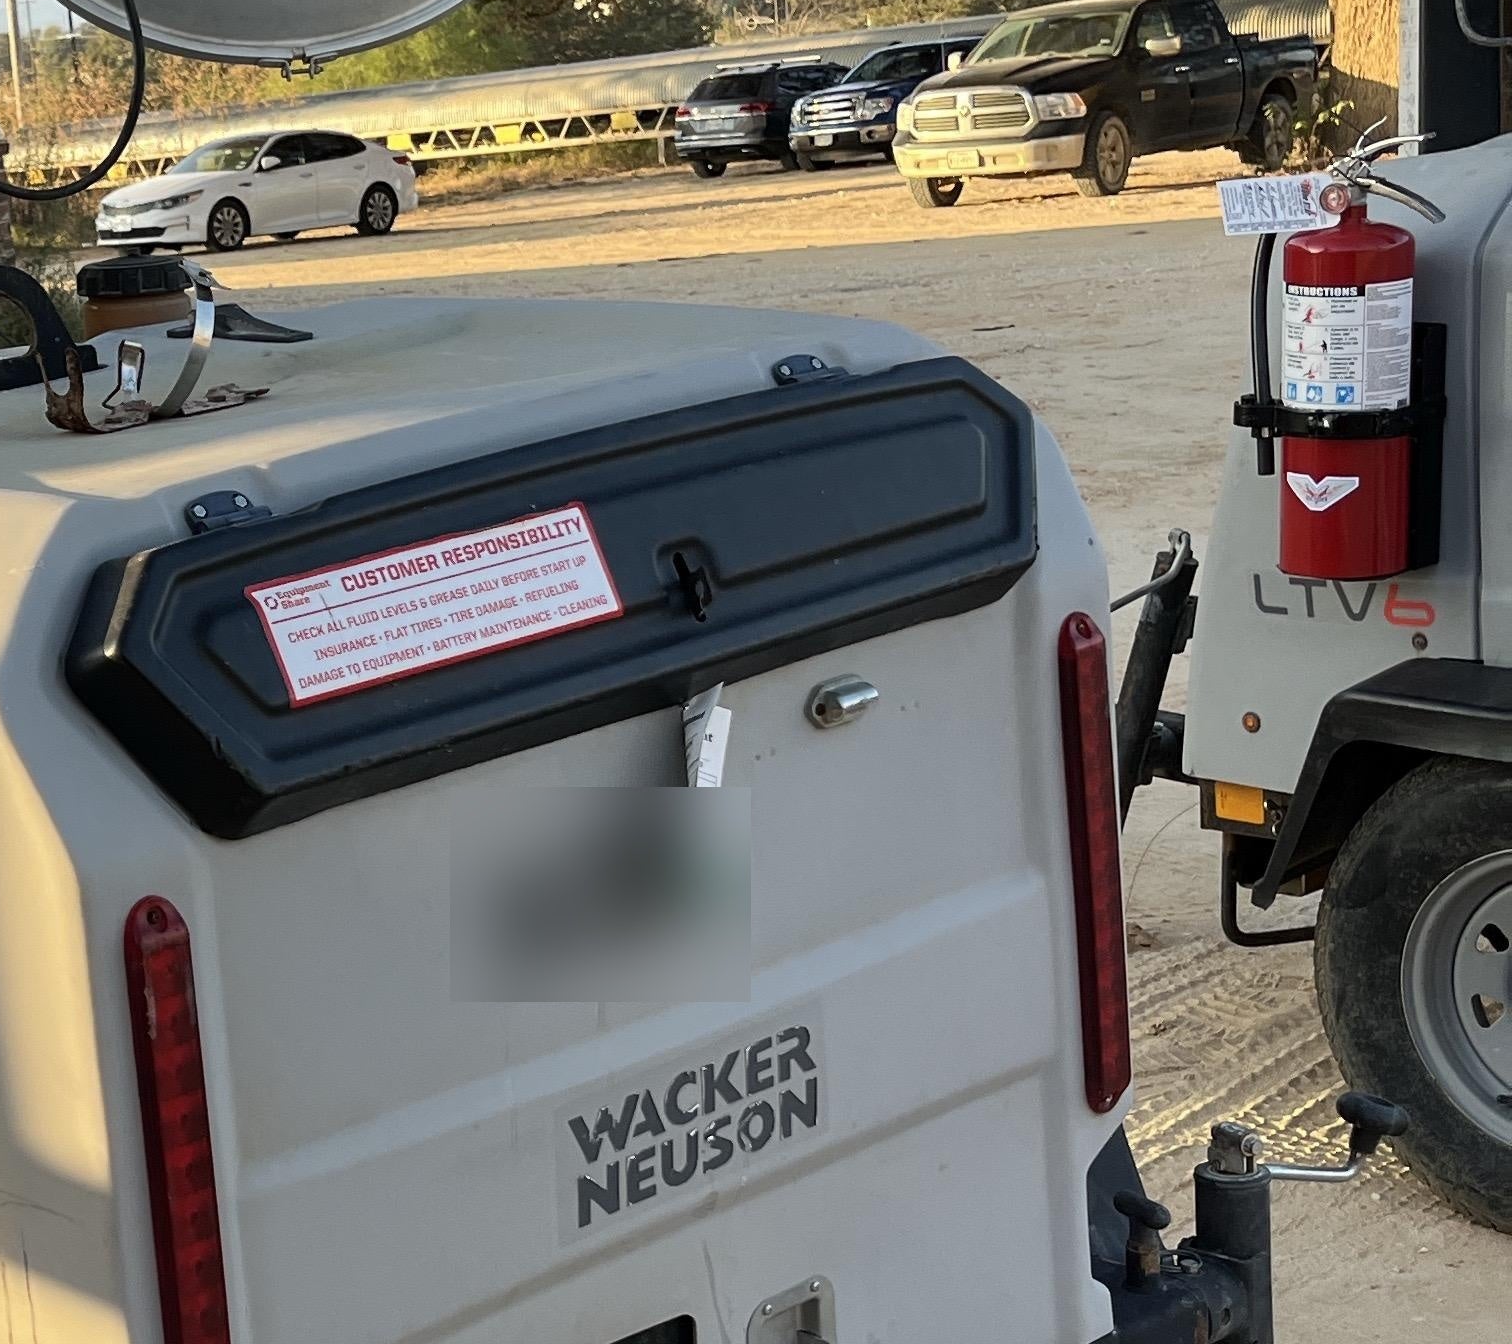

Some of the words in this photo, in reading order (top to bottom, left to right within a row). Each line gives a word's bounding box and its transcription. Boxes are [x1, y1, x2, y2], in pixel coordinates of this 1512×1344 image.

[275, 579, 332, 600] Equipment
[340, 553, 440, 593] CUSTOMER
[441, 516, 584, 568] RESPONSIBILITY
[280, 595, 311, 610] Share
[287, 623, 326, 644] CHECK
[327, 618, 347, 632] ALL
[347, 609, 380, 628] FLUID
[380, 599, 419, 620] LEVELS
[429, 586, 470, 607] GREASE
[472, 577, 501, 595] DAILY
[502, 566, 541, 587] BEFORE
[541, 558, 572, 577] START
[573, 555, 587, 567] UP
[298, 666, 346, 689] DAMAGE
[347, 662, 362, 676] TO
[362, 644, 426, 671] EQUIPMENT
[433, 629, 478, 653] BATTERY
[478, 609, 553, 639] MAINTENANCE
[558, 593, 609, 617] CLEANING
[313, 633, 379, 661] INSURANCE
[384, 625, 409, 642] FLAT
[411, 616, 443, 635] TIRES
[448, 608, 476, 625] TIRE
[477, 596, 519, 617] DAMAGE
[525, 579, 580, 603] REFUELING
[567, 1025, 817, 1164] WACKER
[577, 1076, 818, 1229] NEUSON
